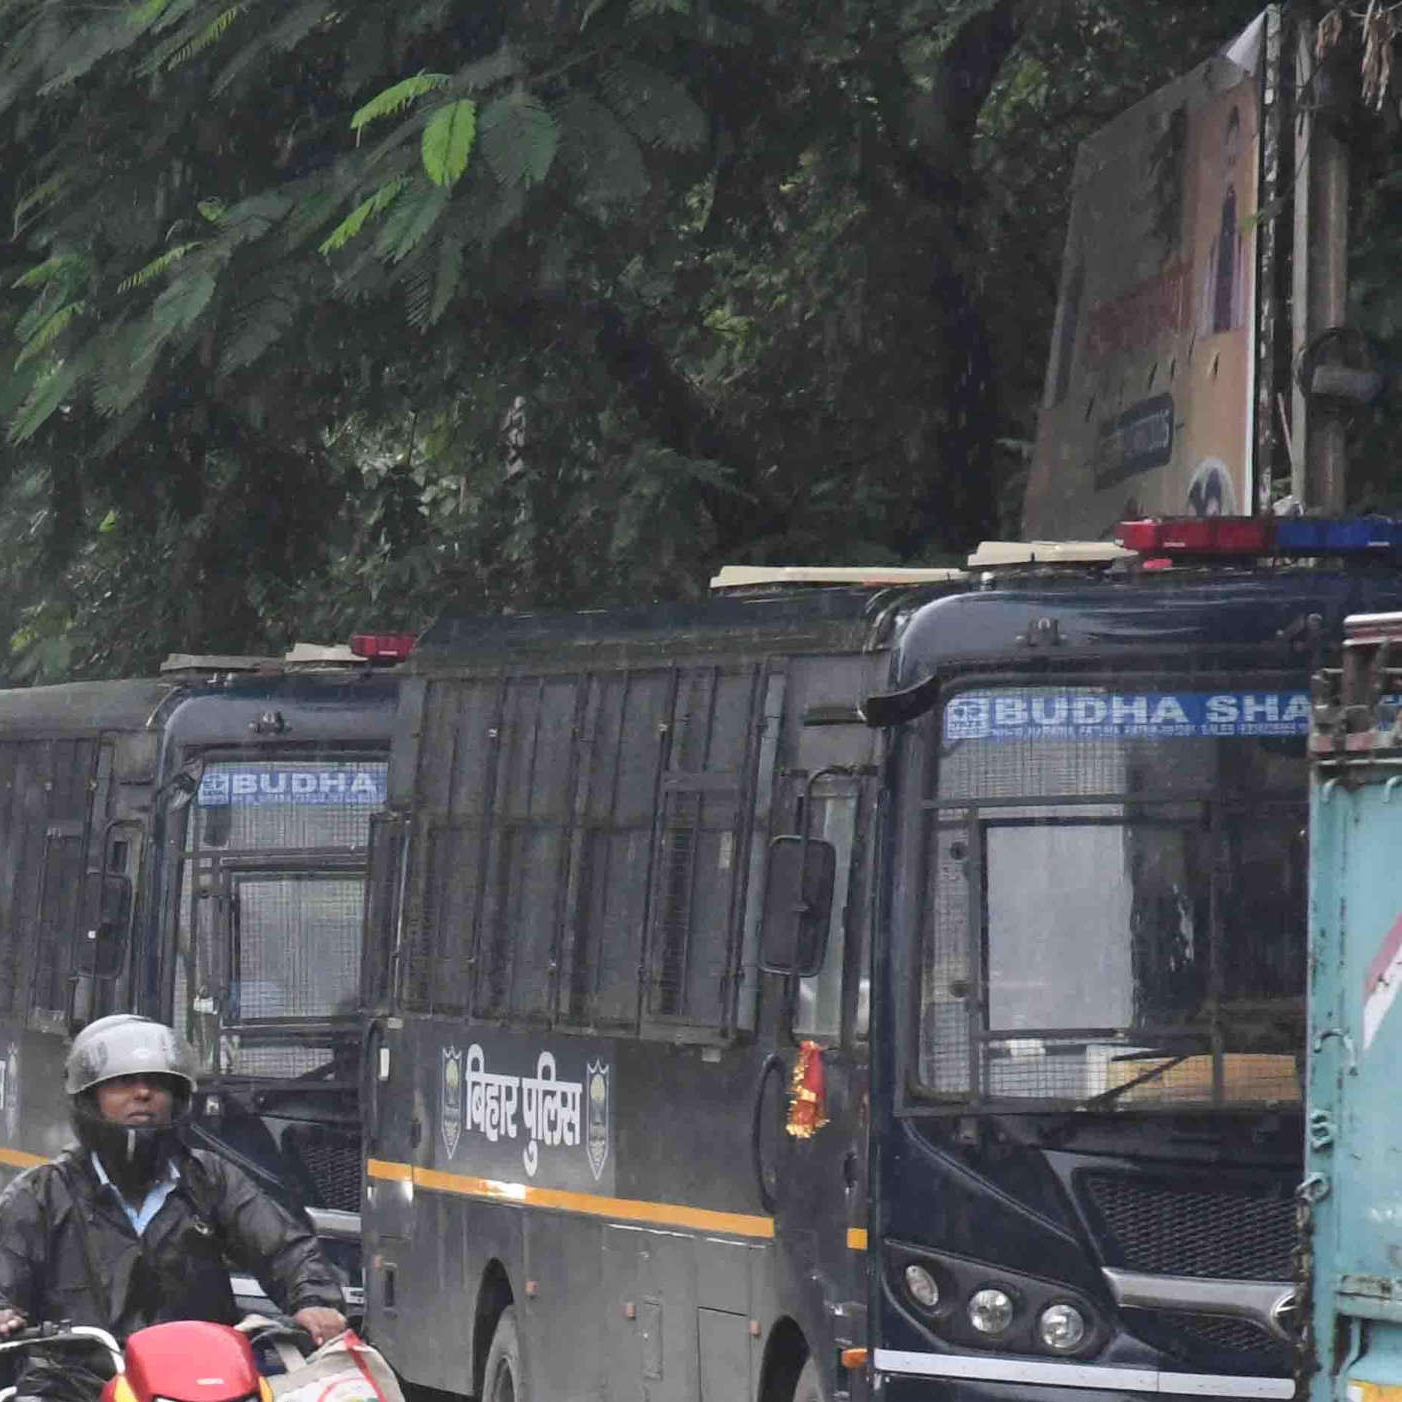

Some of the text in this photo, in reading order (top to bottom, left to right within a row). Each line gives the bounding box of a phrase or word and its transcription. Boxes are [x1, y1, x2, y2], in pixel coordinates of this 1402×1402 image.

[994, 695, 1189, 725] BUDHA
[232, 773, 378, 794] BUDHA
[465, 1043, 583, 1177] बिहार पुलिस
